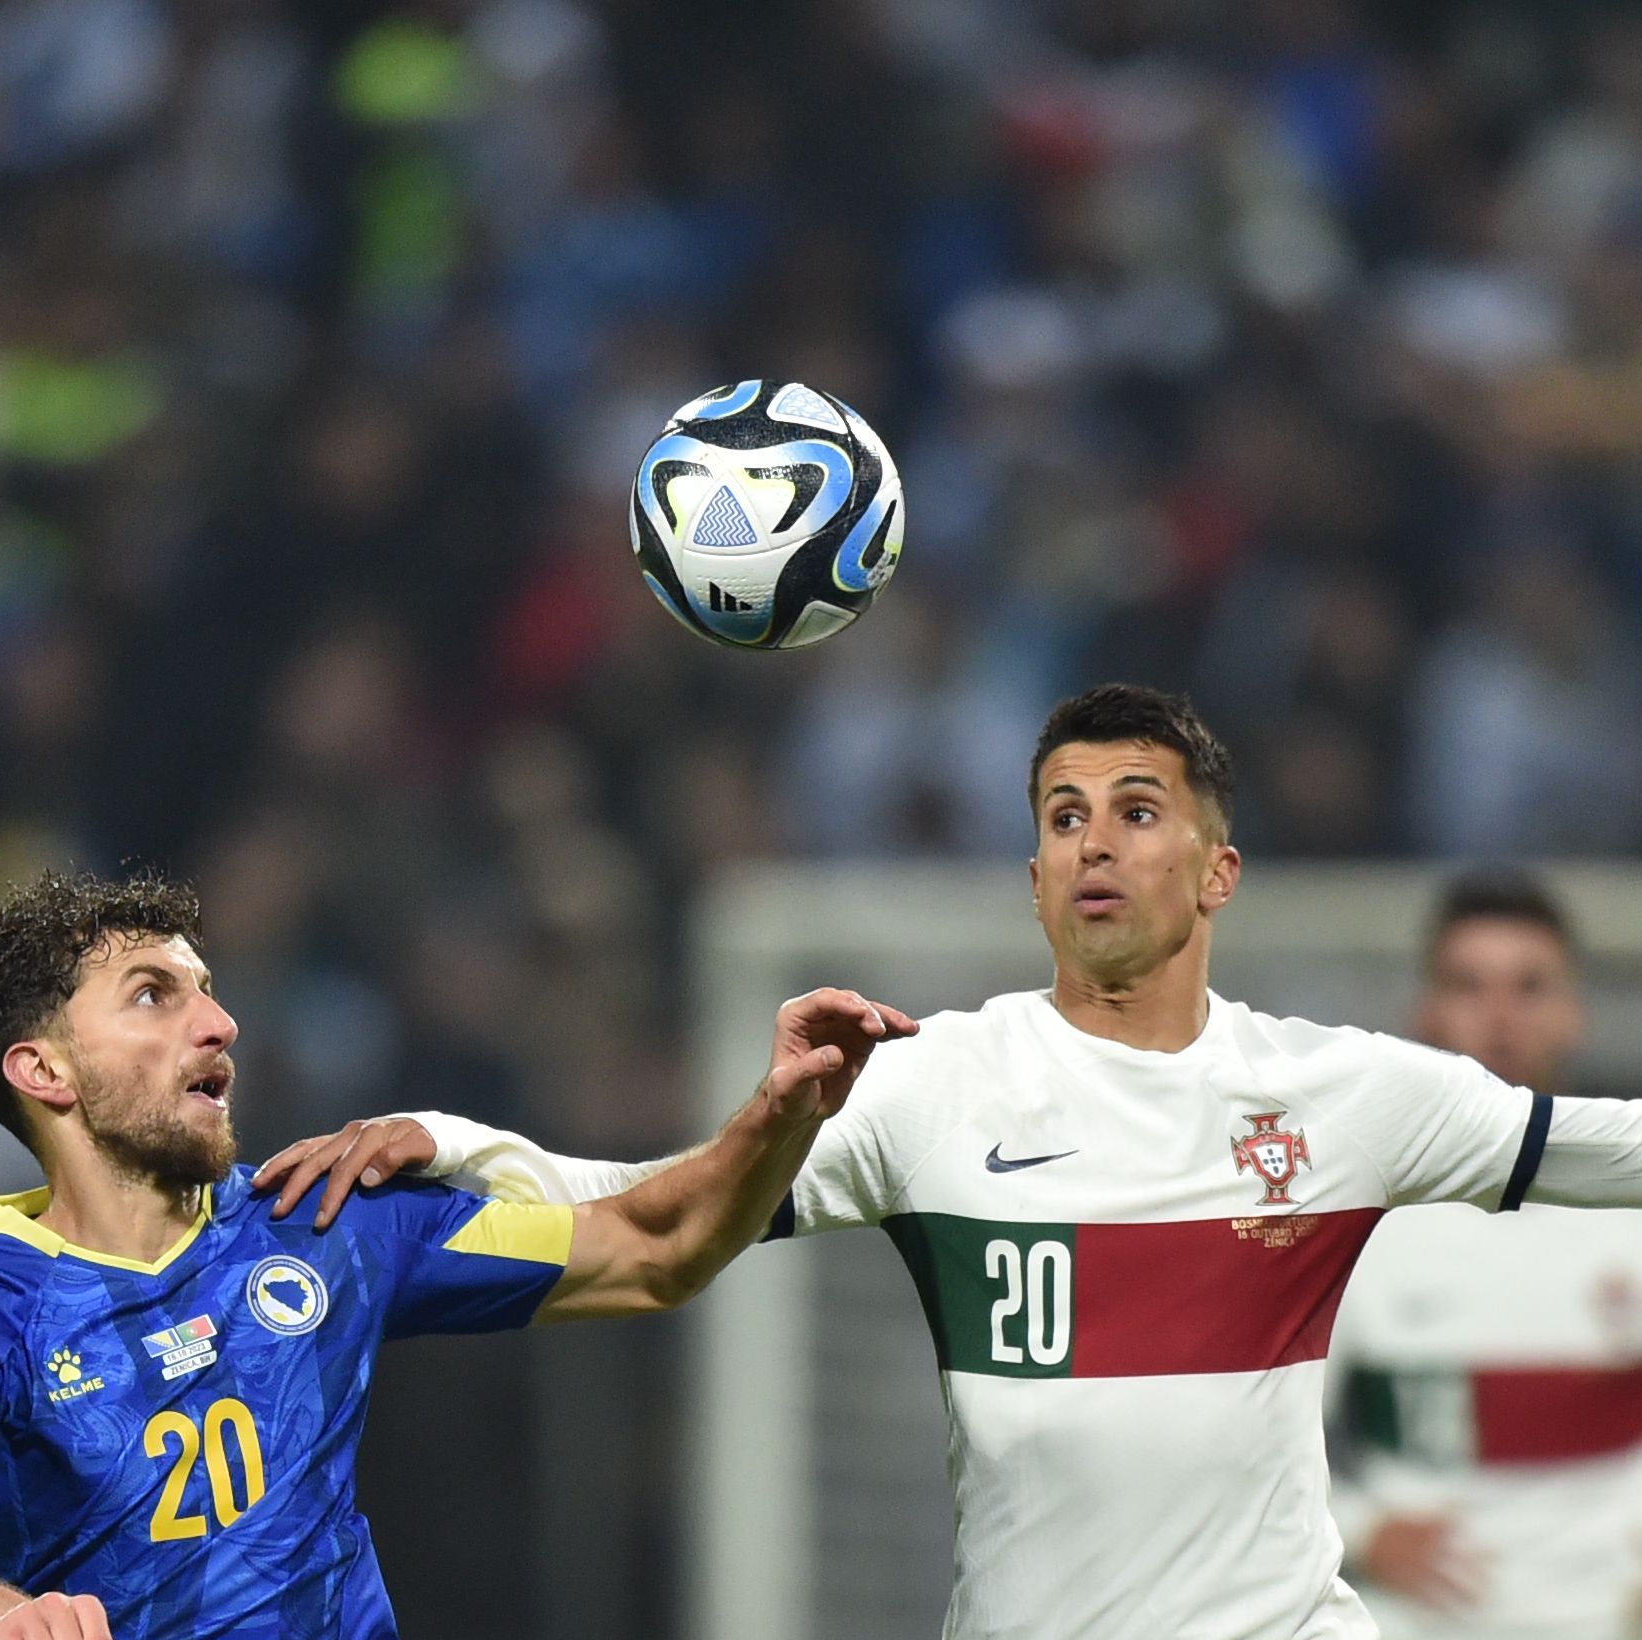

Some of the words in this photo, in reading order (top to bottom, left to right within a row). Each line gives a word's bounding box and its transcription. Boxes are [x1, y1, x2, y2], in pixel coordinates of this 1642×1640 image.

[983, 1238, 1072, 1366] 20
[48, 1377, 105, 1402] KELME
[143, 1397, 266, 1543] 20
